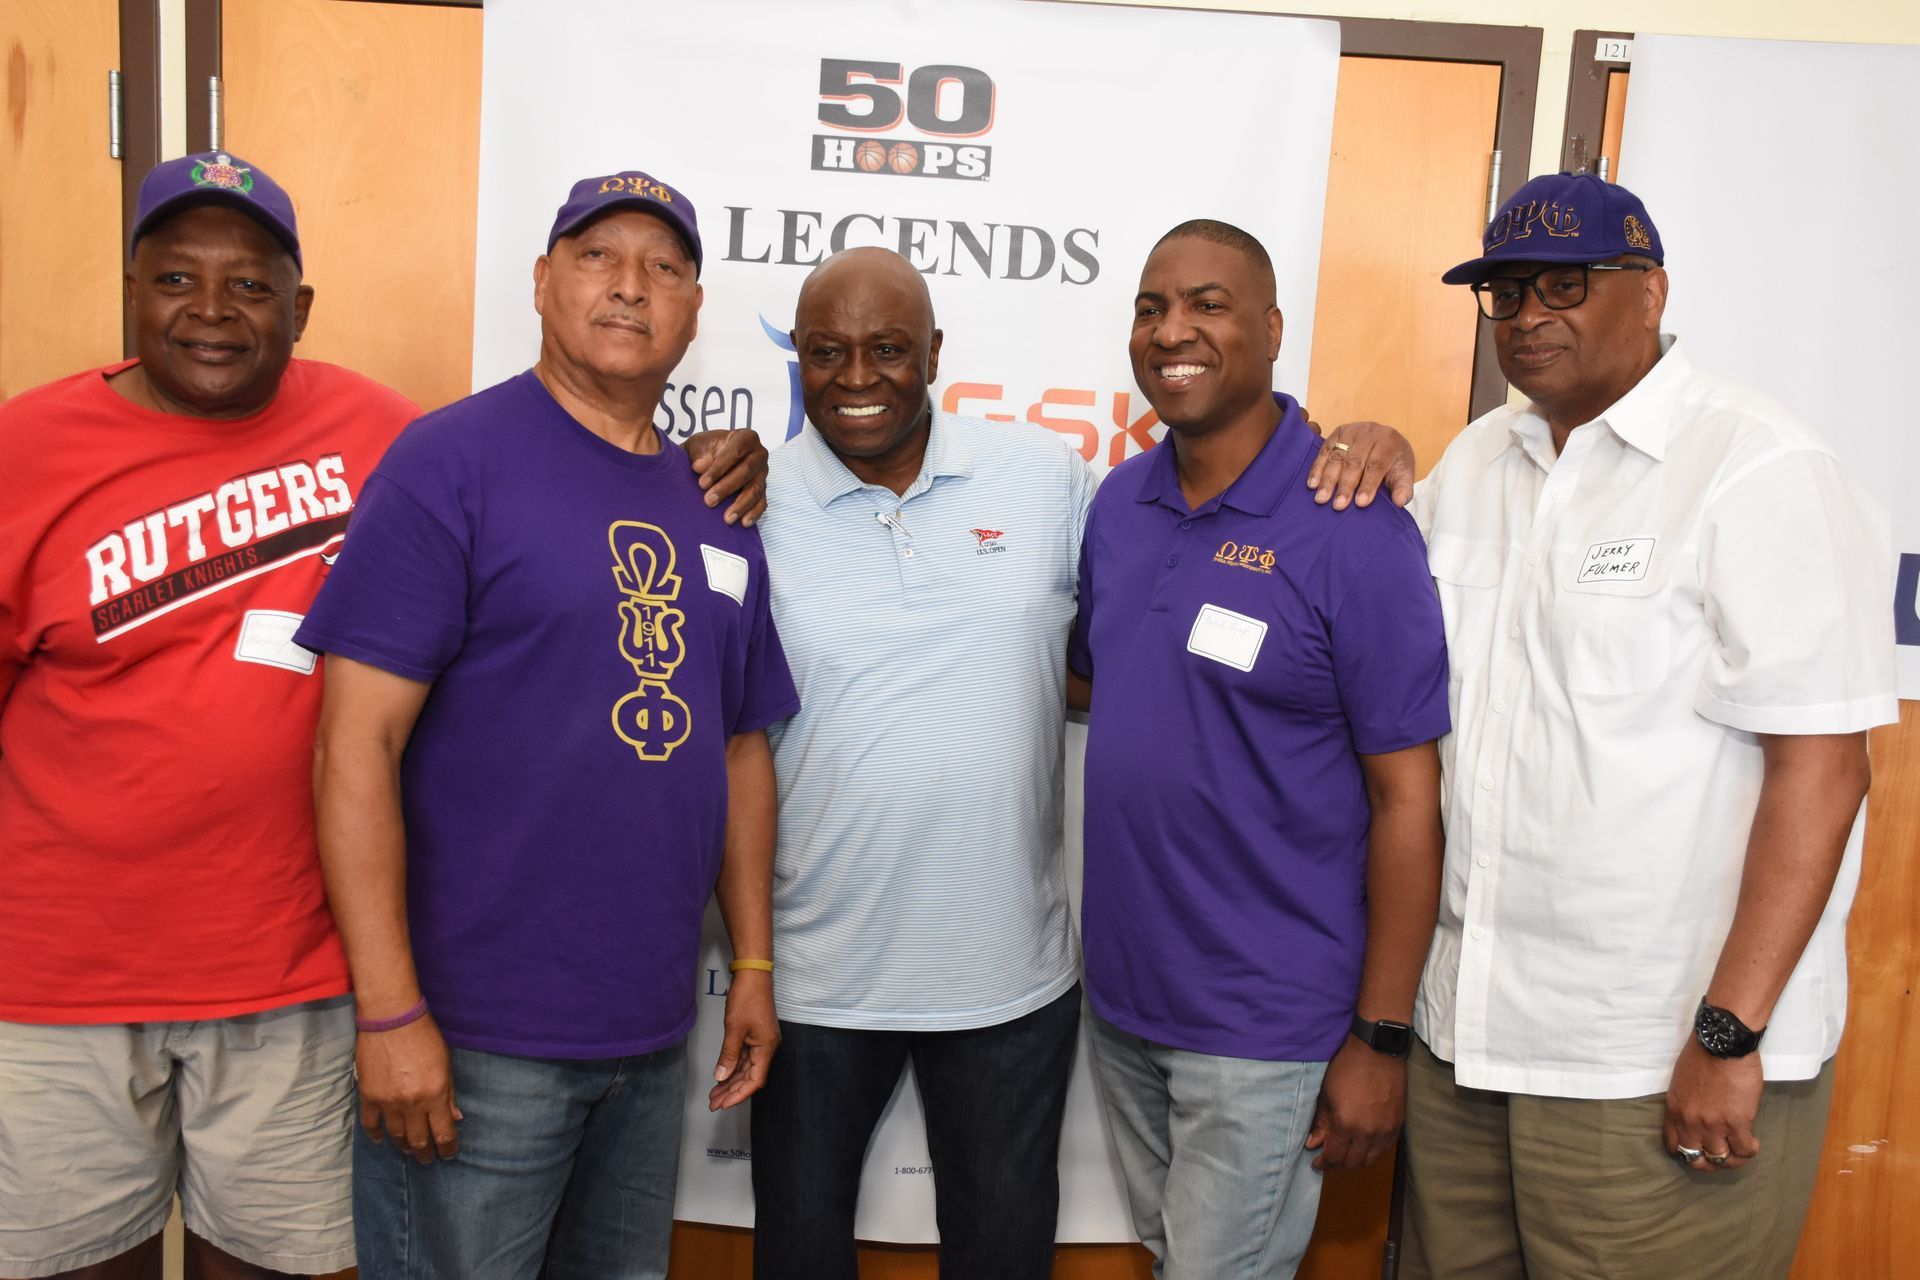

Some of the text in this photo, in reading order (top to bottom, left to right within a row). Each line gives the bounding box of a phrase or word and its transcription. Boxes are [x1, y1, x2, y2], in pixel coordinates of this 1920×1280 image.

[1603, 43, 1627, 58] 121
[818, 58, 996, 138] 50
[86, 454, 353, 606] RUTGERS
[1591, 543, 1635, 560] JERRY
[97, 548, 260, 630] SCARLET KNIGHTS
[1582, 561, 1640, 577] FULMER
